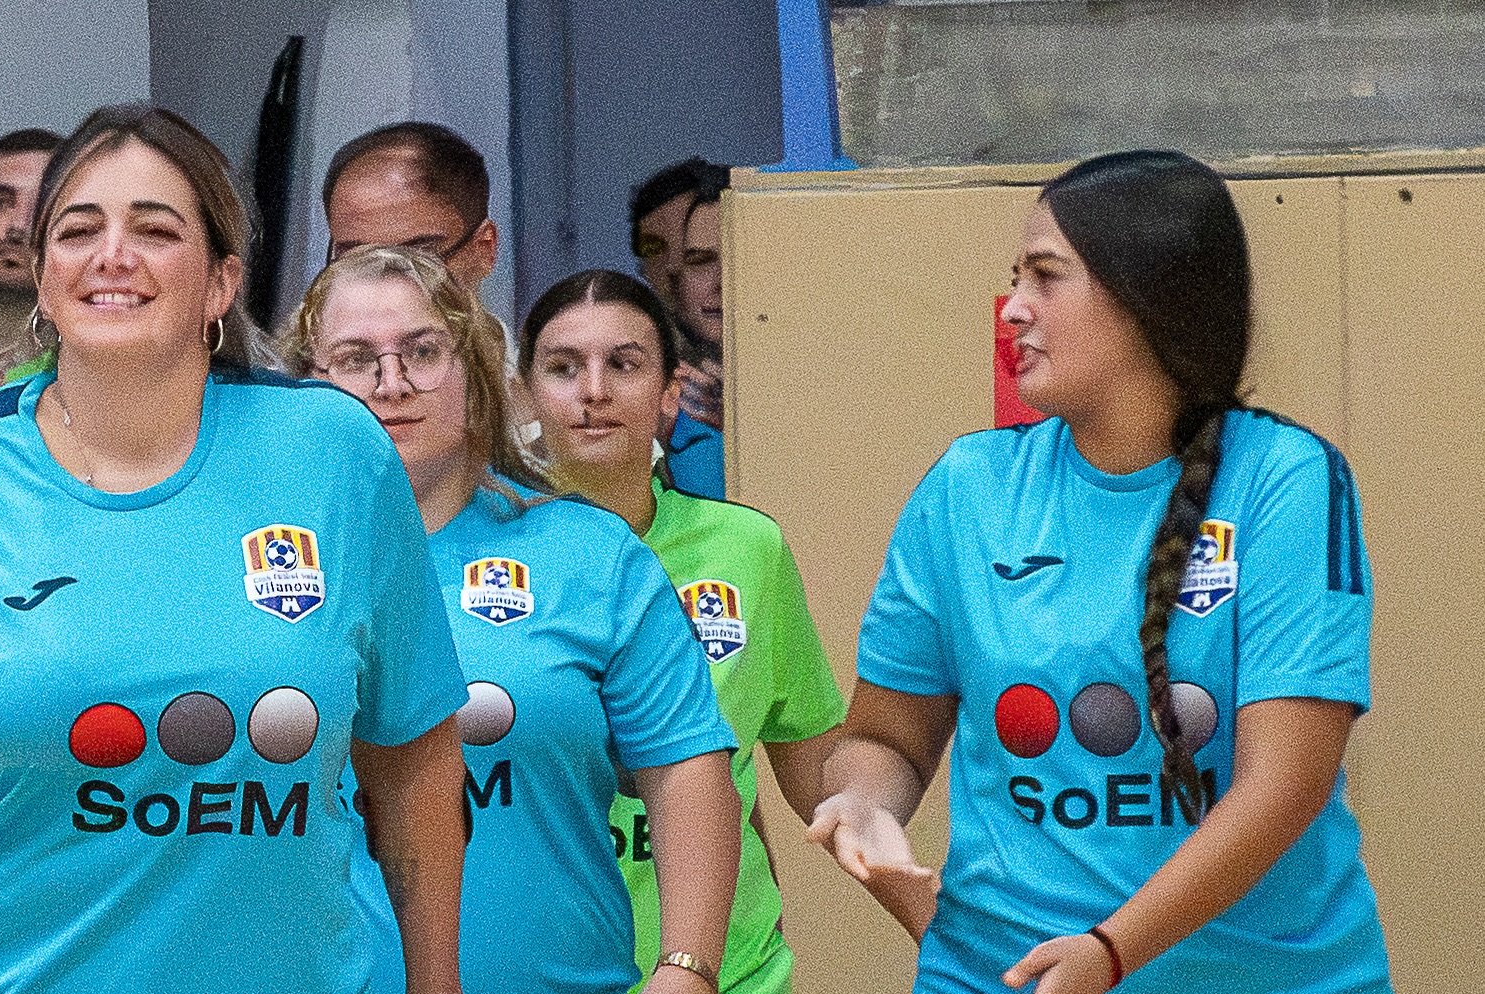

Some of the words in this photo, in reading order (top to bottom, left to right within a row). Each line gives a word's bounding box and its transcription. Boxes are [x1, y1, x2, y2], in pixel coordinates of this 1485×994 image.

[254, 581, 320, 596] Vilanova
[468, 595, 527, 609] Vilanova
[71, 779, 310, 838] SoEM
